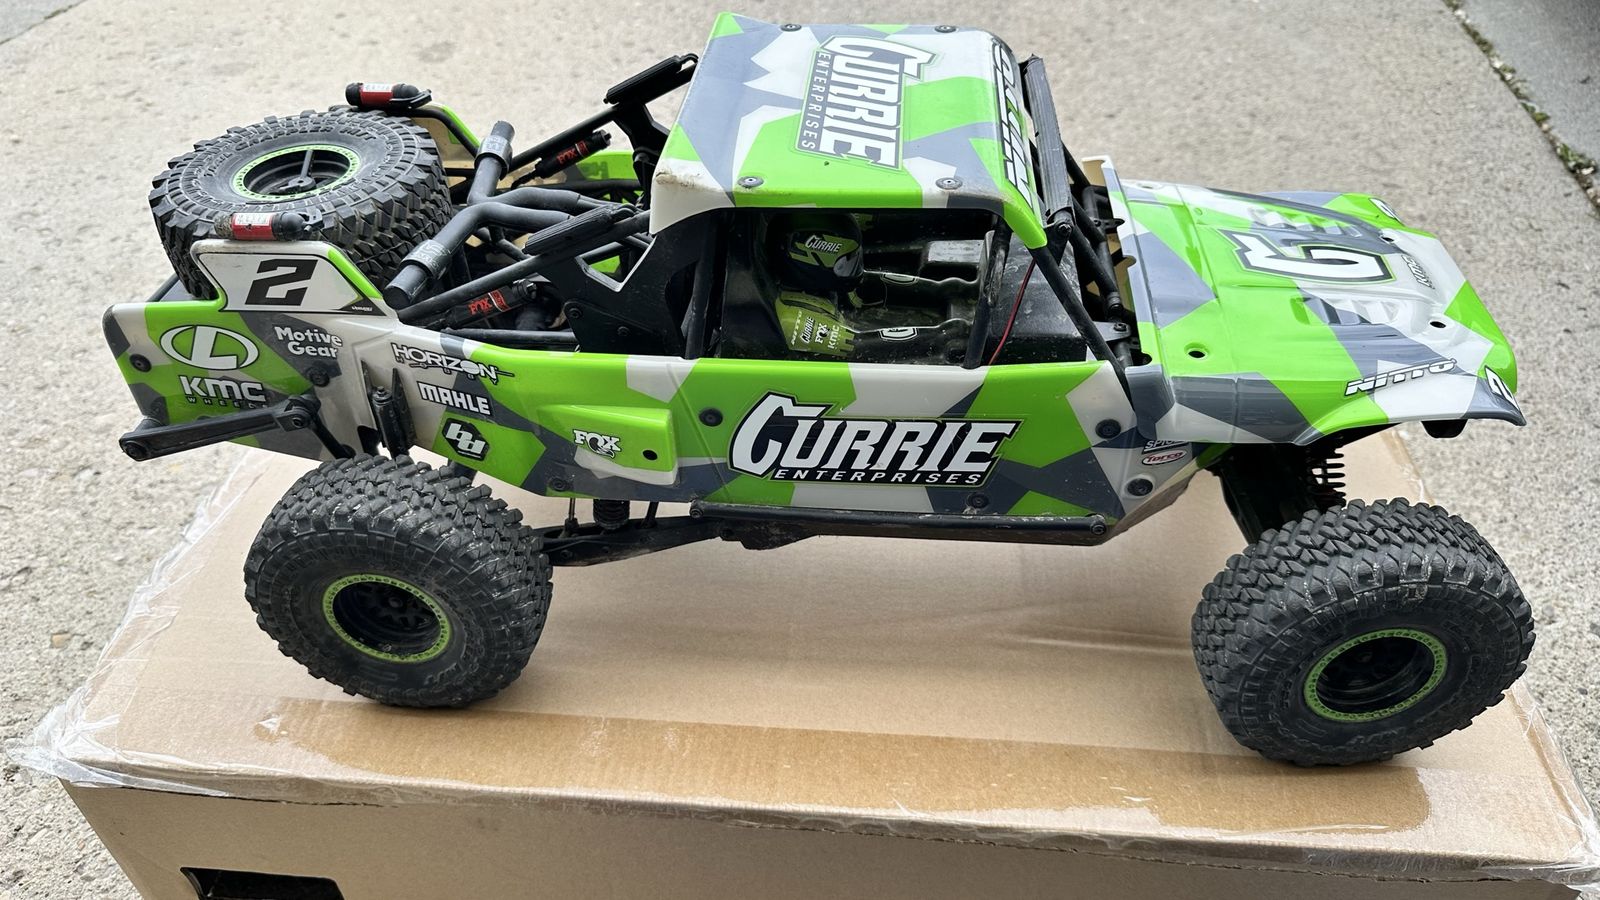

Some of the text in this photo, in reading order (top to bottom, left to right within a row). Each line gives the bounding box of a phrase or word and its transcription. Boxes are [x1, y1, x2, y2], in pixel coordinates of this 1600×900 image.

[801, 52, 831, 149] ENTERPRISES
[820, 36, 935, 168] CURRIE
[805, 234, 843, 253] CURRIE
[245, 259, 318, 306] 2
[274, 326, 343, 347] Motive
[800, 316, 815, 344] CURRIE
[815, 322, 830, 344] FOX
[287, 341, 339, 358] Gear
[391, 342, 498, 380] HORIZON
[179, 375, 267, 402] KMC
[1344, 359, 1456, 396] NITTO
[417, 382, 491, 416] MAHLE
[573, 429, 622, 458] FOX
[731, 393, 1017, 476] CURRIE
[774, 469, 981, 484] ENTERPRISES
